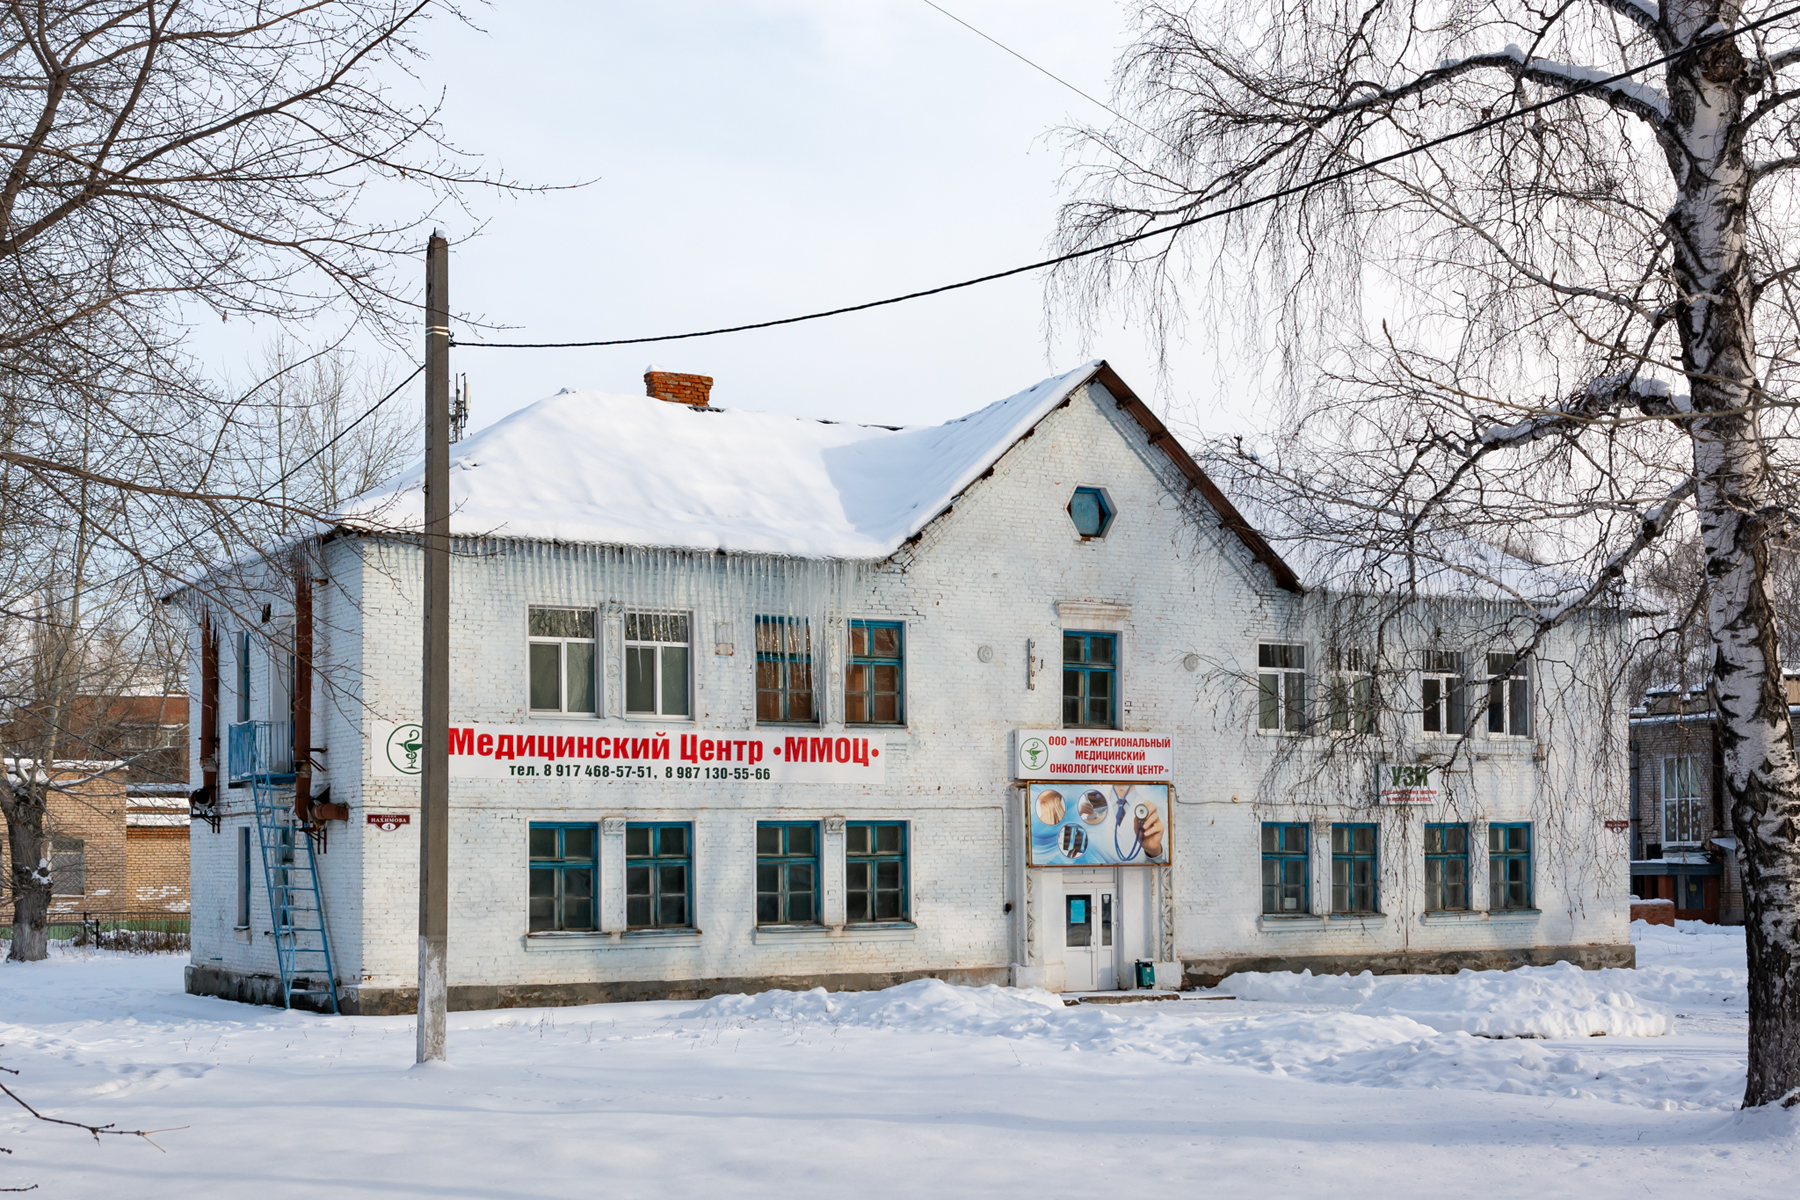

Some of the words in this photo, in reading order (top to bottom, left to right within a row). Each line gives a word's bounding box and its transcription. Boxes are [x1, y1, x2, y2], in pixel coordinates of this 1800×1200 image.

[448, 727, 670, 761] Медицинский
[680, 733, 764, 765] Центр
[1048, 735, 1067, 746] ООО
[1069, 736, 1171, 748] «МЕЖРЕГИОНАЛЬНЫЙ
[1075, 750, 1146, 761] МЕДИЦИНСКИЙ
[509, 765, 539, 776] тел.
[543, 764, 552, 777] 8
[555, 764, 581, 777] 917
[585, 765, 657, 779] 468-57-51,
[665, 766, 673, 779] 8
[676, 766, 700, 779] 987
[704, 767, 771, 780] 130-55-66
[1049, 763, 1134, 774] ОНКОЛОГИЧЕСКИЙ
[1136, 764, 1169, 776] ЦЕНТР»
